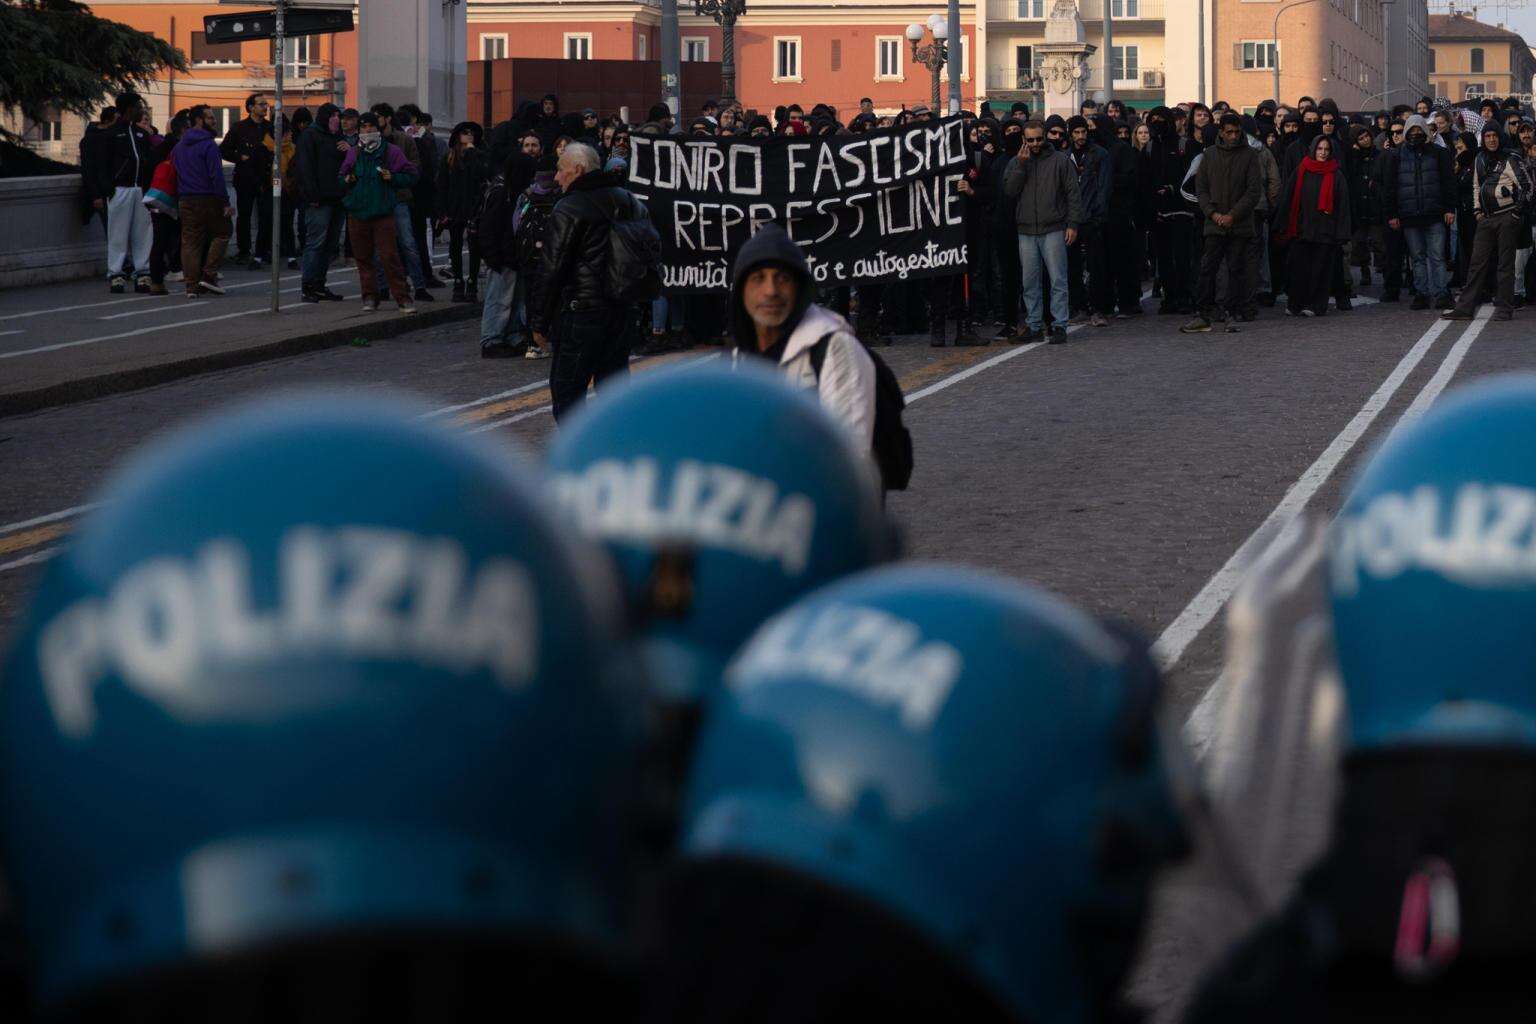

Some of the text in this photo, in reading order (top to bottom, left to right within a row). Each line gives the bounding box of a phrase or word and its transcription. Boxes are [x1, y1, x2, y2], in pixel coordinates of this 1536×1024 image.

[628, 120, 967, 195] CONTRO FASCISMO
[673, 174, 965, 253] REPRESSIONE
[833, 262, 848, 280] e
[38, 524, 543, 740] POLIZIA
